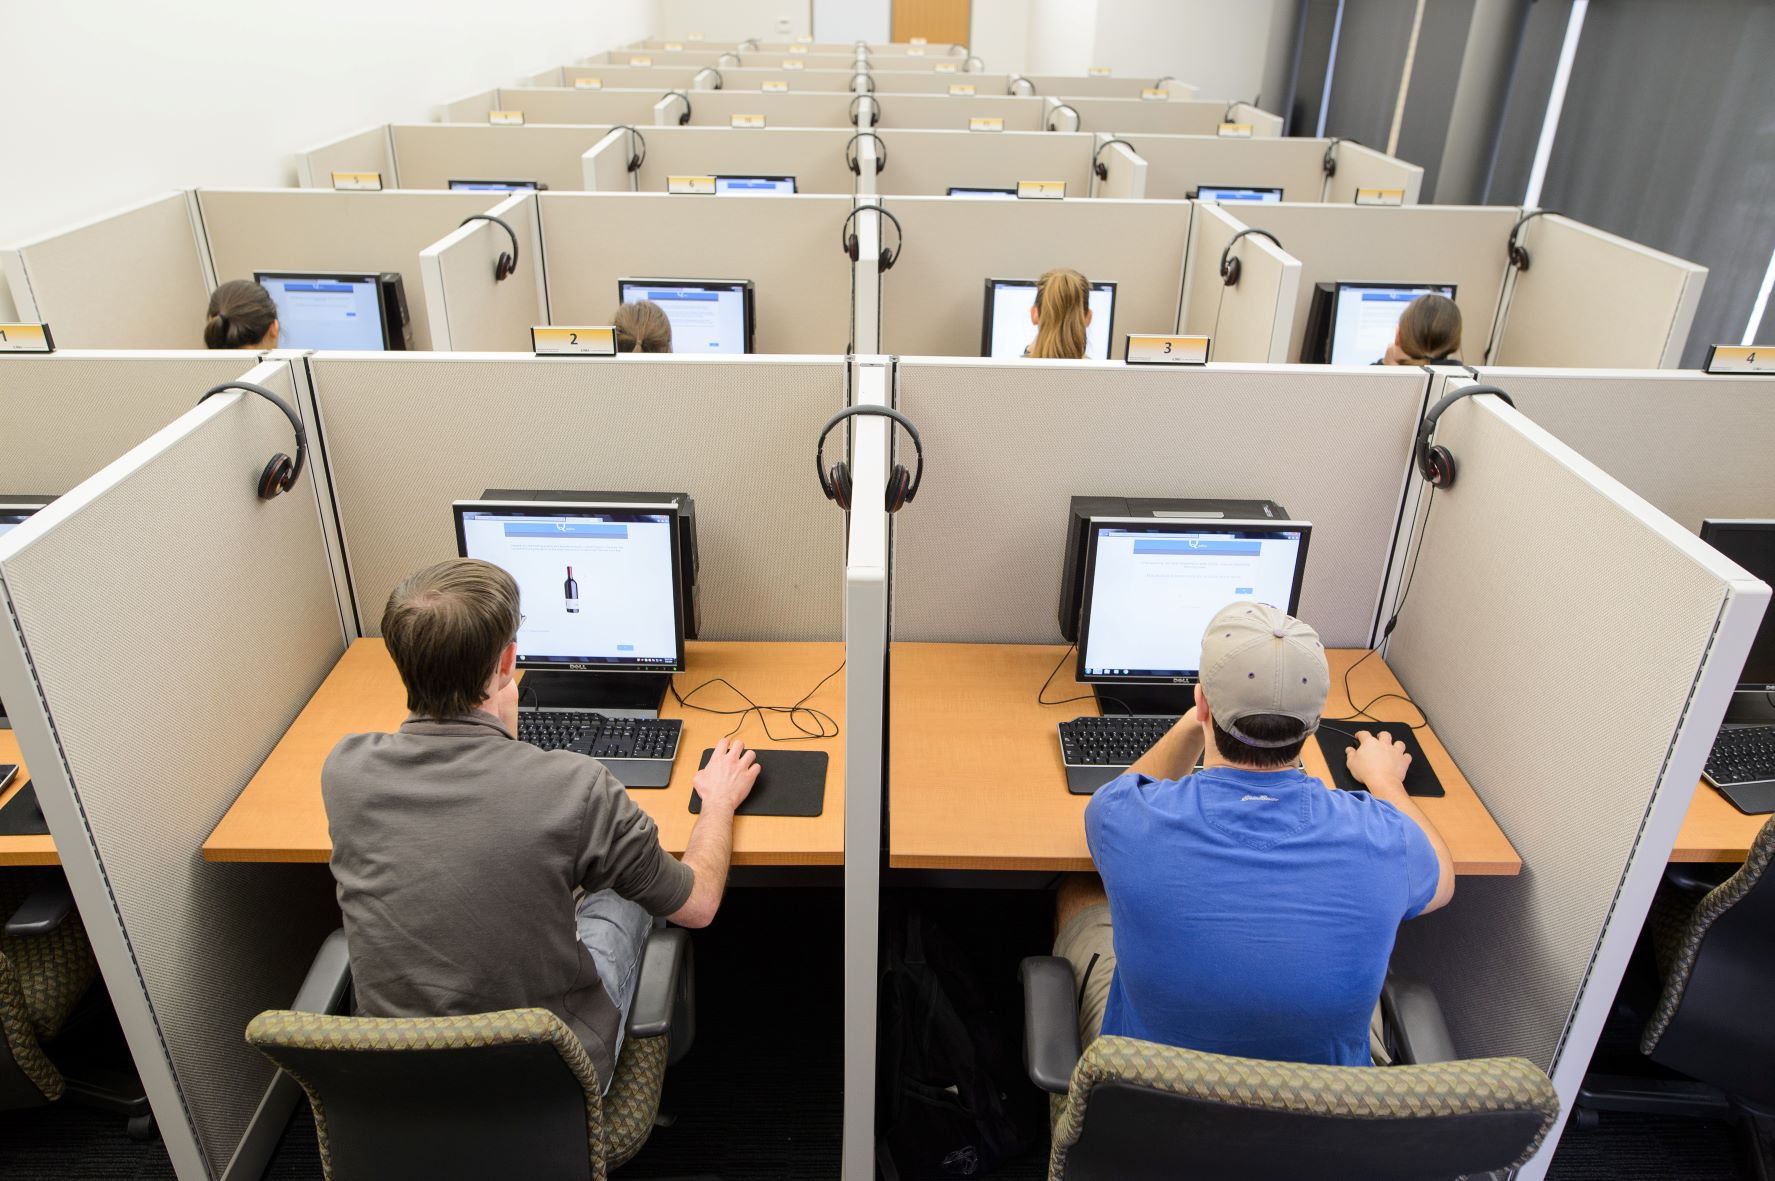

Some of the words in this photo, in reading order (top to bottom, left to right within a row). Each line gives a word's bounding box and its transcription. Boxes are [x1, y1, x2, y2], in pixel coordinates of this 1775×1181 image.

[569, 333, 578, 345] 2
[1163, 341, 1172, 354] 3
[1746, 352, 1756, 363] 4
